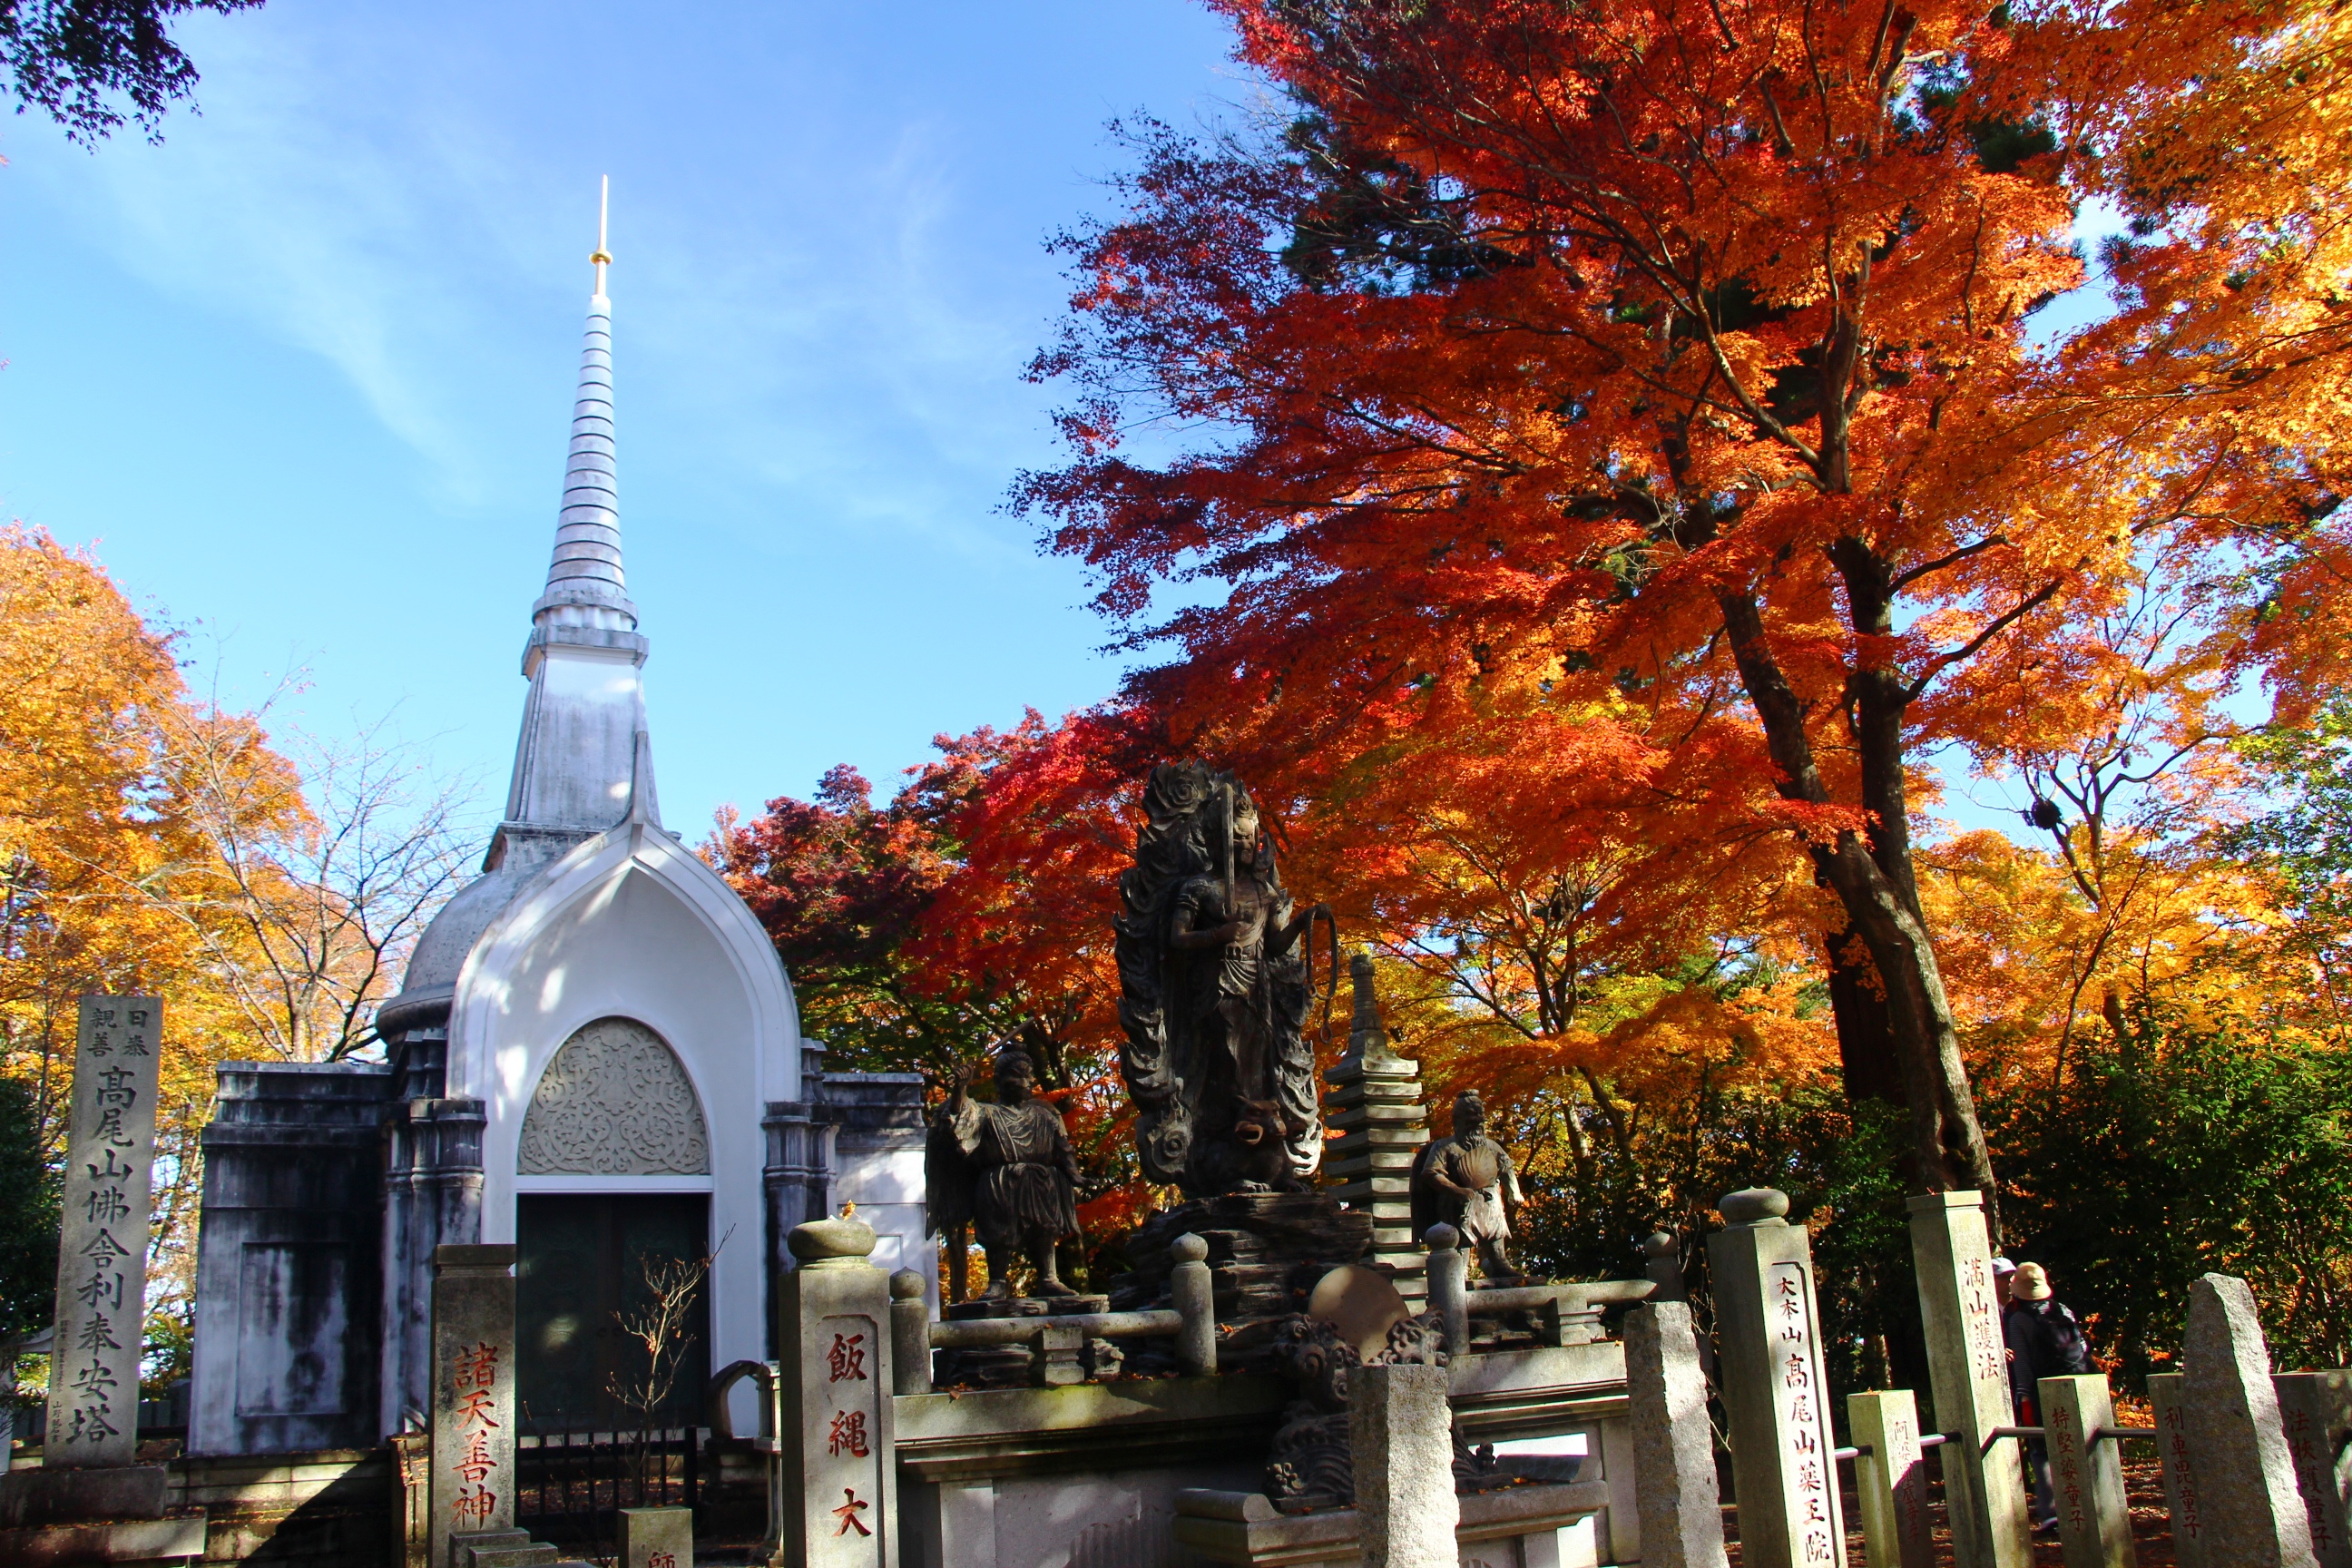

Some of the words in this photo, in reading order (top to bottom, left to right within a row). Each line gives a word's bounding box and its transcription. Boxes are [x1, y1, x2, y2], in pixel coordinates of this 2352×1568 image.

[87, 1007, 118, 1058] 親善
[123, 1009, 150, 1056] 日泰
[1964, 1257, 1999, 1380] 満山護法
[449, 1341, 500, 1530] 諸天善神
[826, 1333, 872, 1537] 飯縄大
[2052, 1407, 2085, 1532] 持堅婆童子
